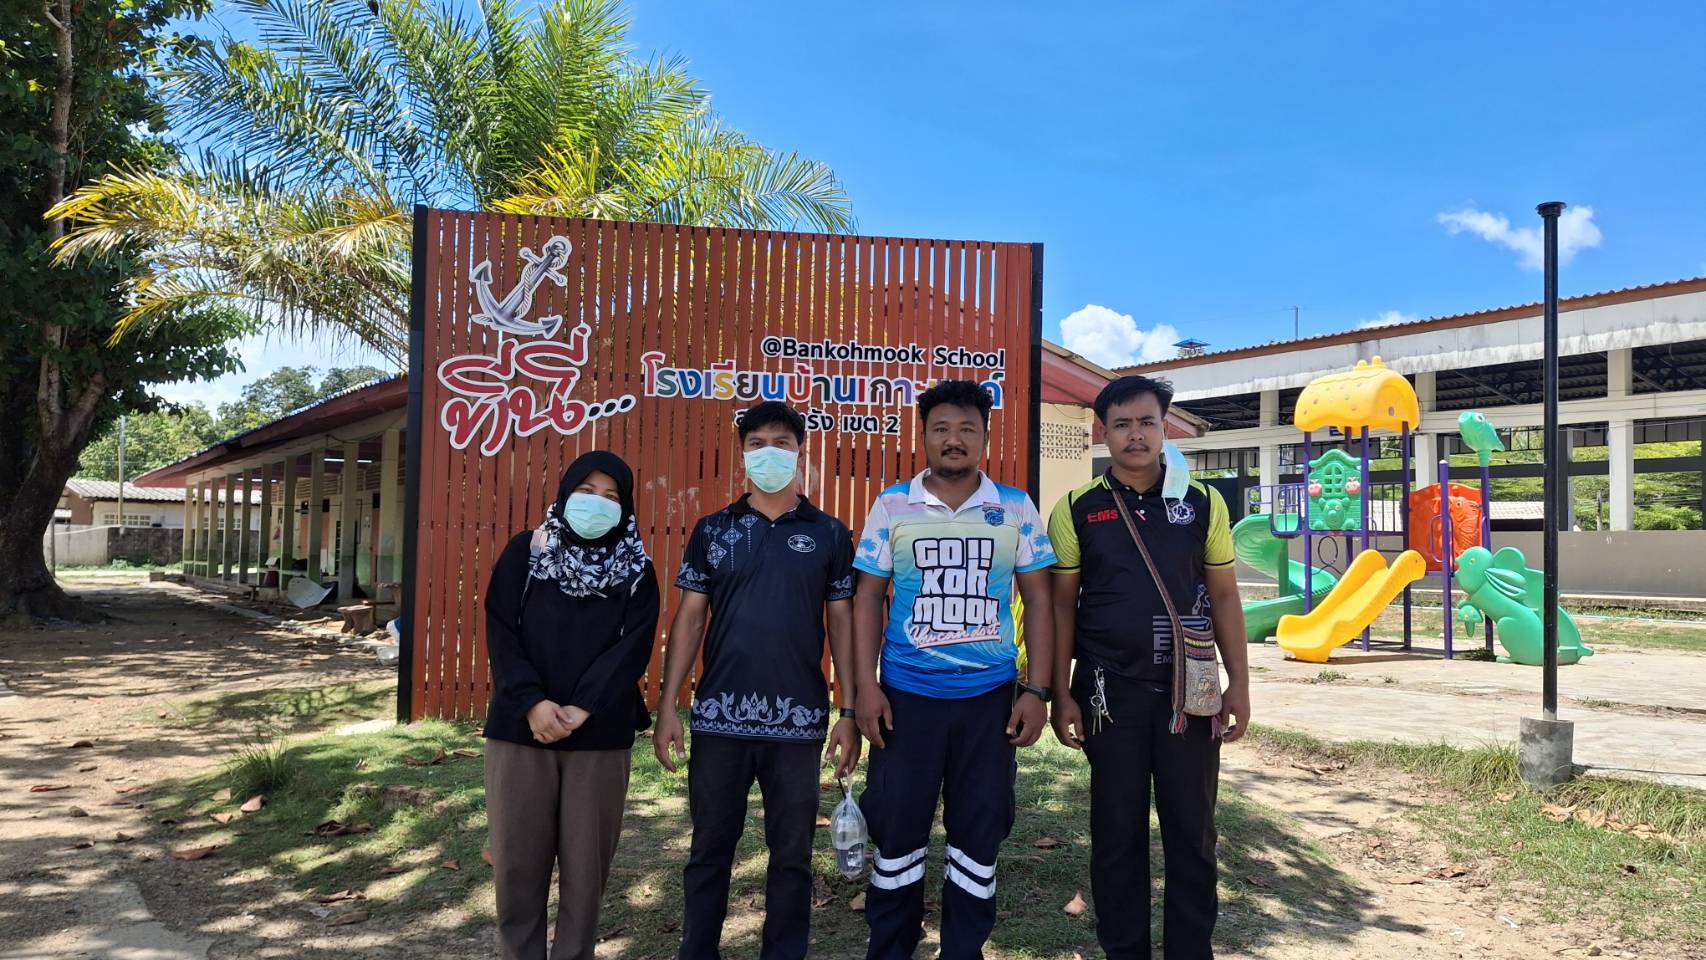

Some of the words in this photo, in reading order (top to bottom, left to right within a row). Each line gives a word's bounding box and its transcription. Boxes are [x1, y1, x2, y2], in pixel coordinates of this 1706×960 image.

[763, 337, 924, 364] @Bankohmook
[935, 346, 1005, 368] School
[842, 414, 879, 433] เขต
[885, 415, 899, 434] 2
[1087, 509, 1120, 524] EMS
